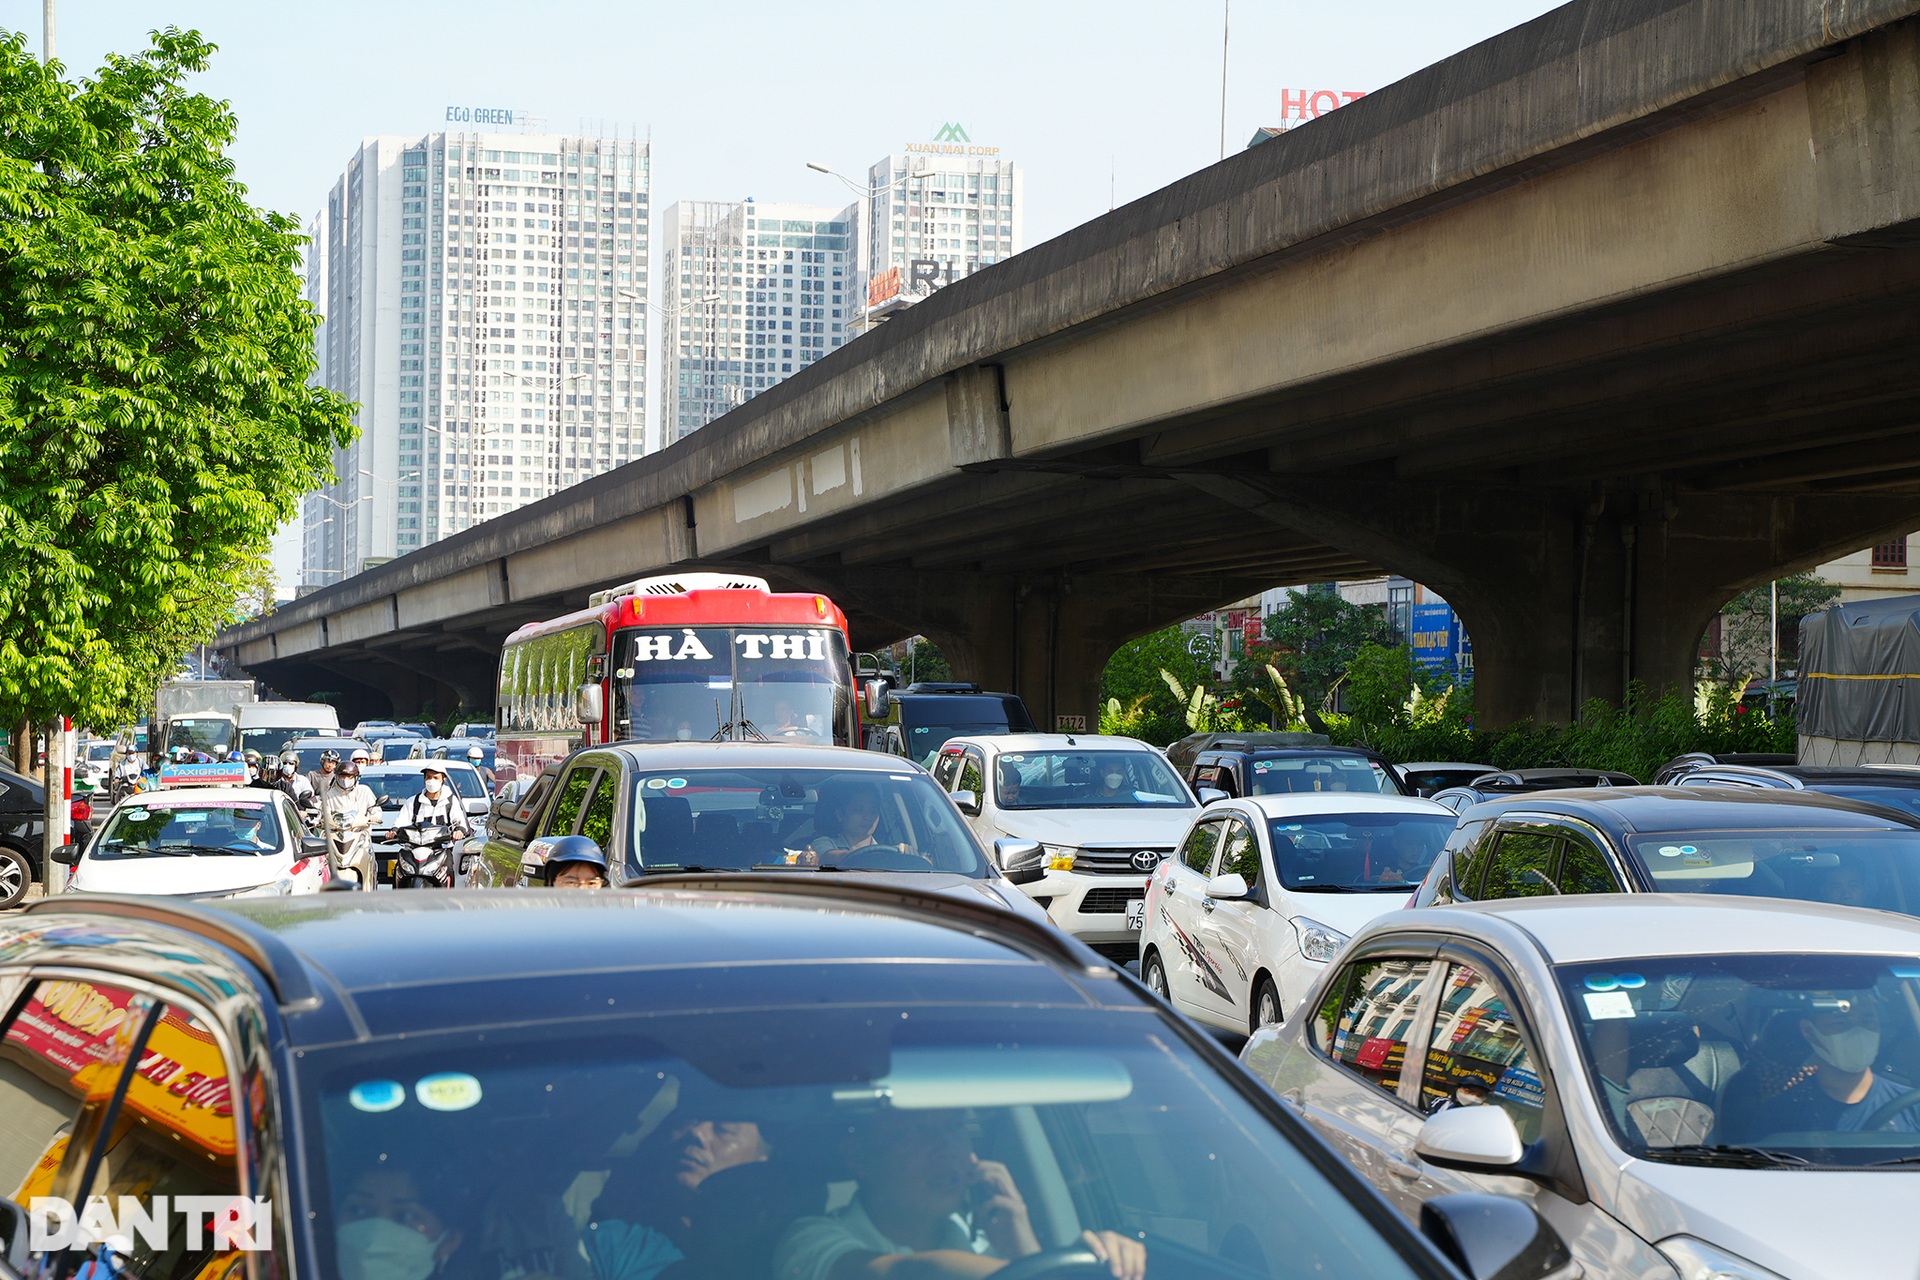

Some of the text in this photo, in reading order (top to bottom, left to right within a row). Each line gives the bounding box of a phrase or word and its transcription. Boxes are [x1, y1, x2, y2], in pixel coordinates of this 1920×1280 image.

[446, 106, 513, 125] ECO GREEN
[905, 143, 1000, 156] XUAN MAI CORP
[634, 628, 714, 661] HÀ
